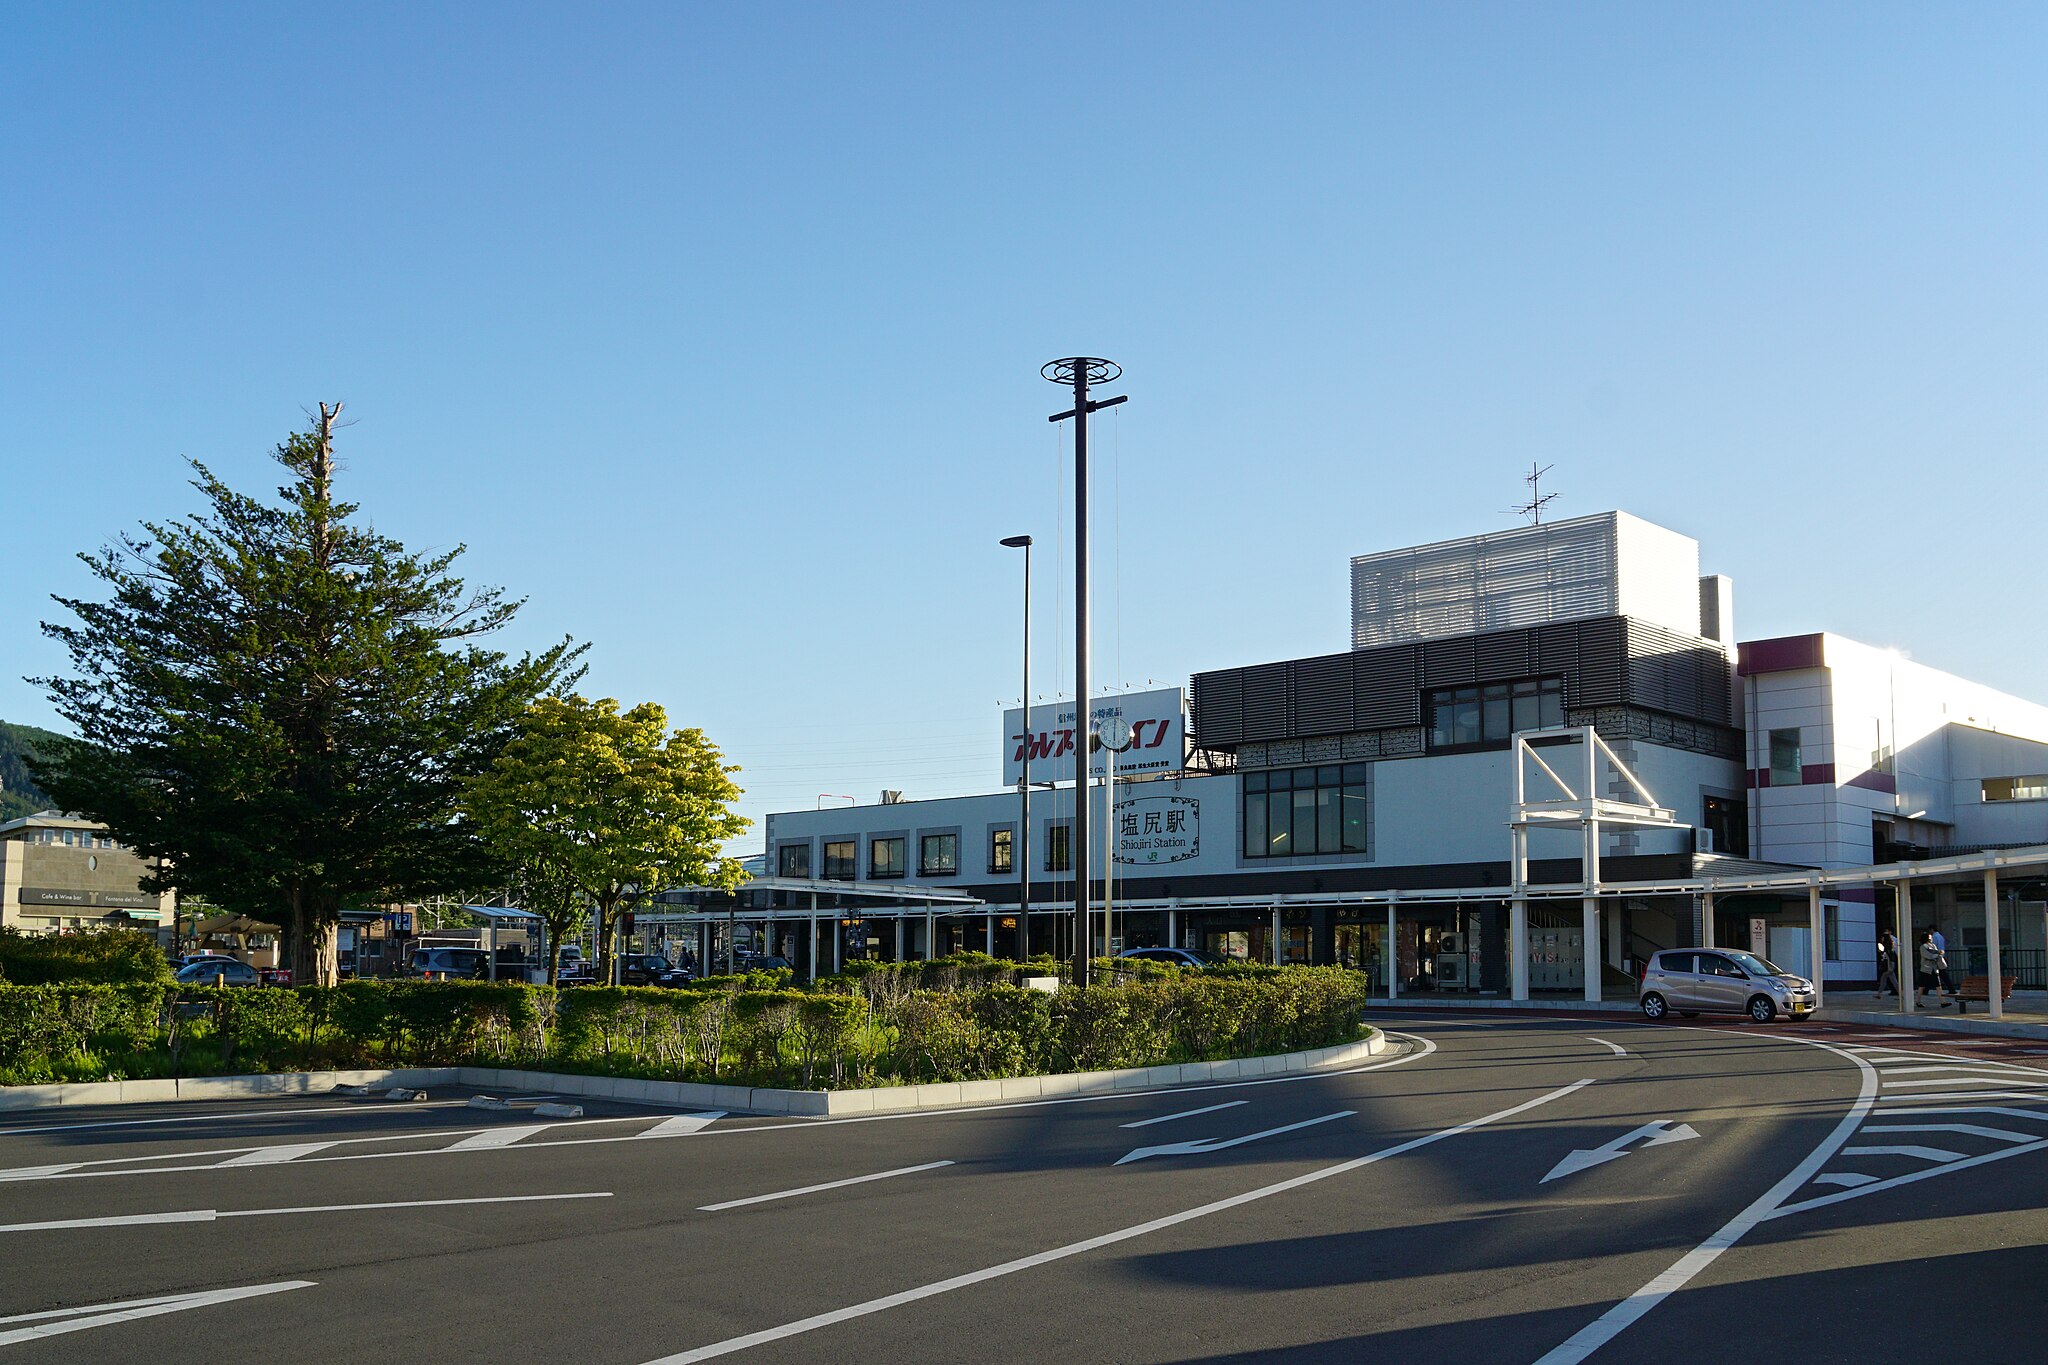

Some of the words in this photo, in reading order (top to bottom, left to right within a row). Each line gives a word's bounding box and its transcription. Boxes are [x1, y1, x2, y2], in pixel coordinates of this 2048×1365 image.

[1058, 706, 1122, 723] 信州の特産品
[1012, 719, 1170, 762] アルプイン
[1121, 810, 1186, 836] 塩尻駅
[1121, 838, 1152, 850] Shiojiri
[1154, 837, 1186, 848] Station
[1148, 852, 1158, 860] JR
